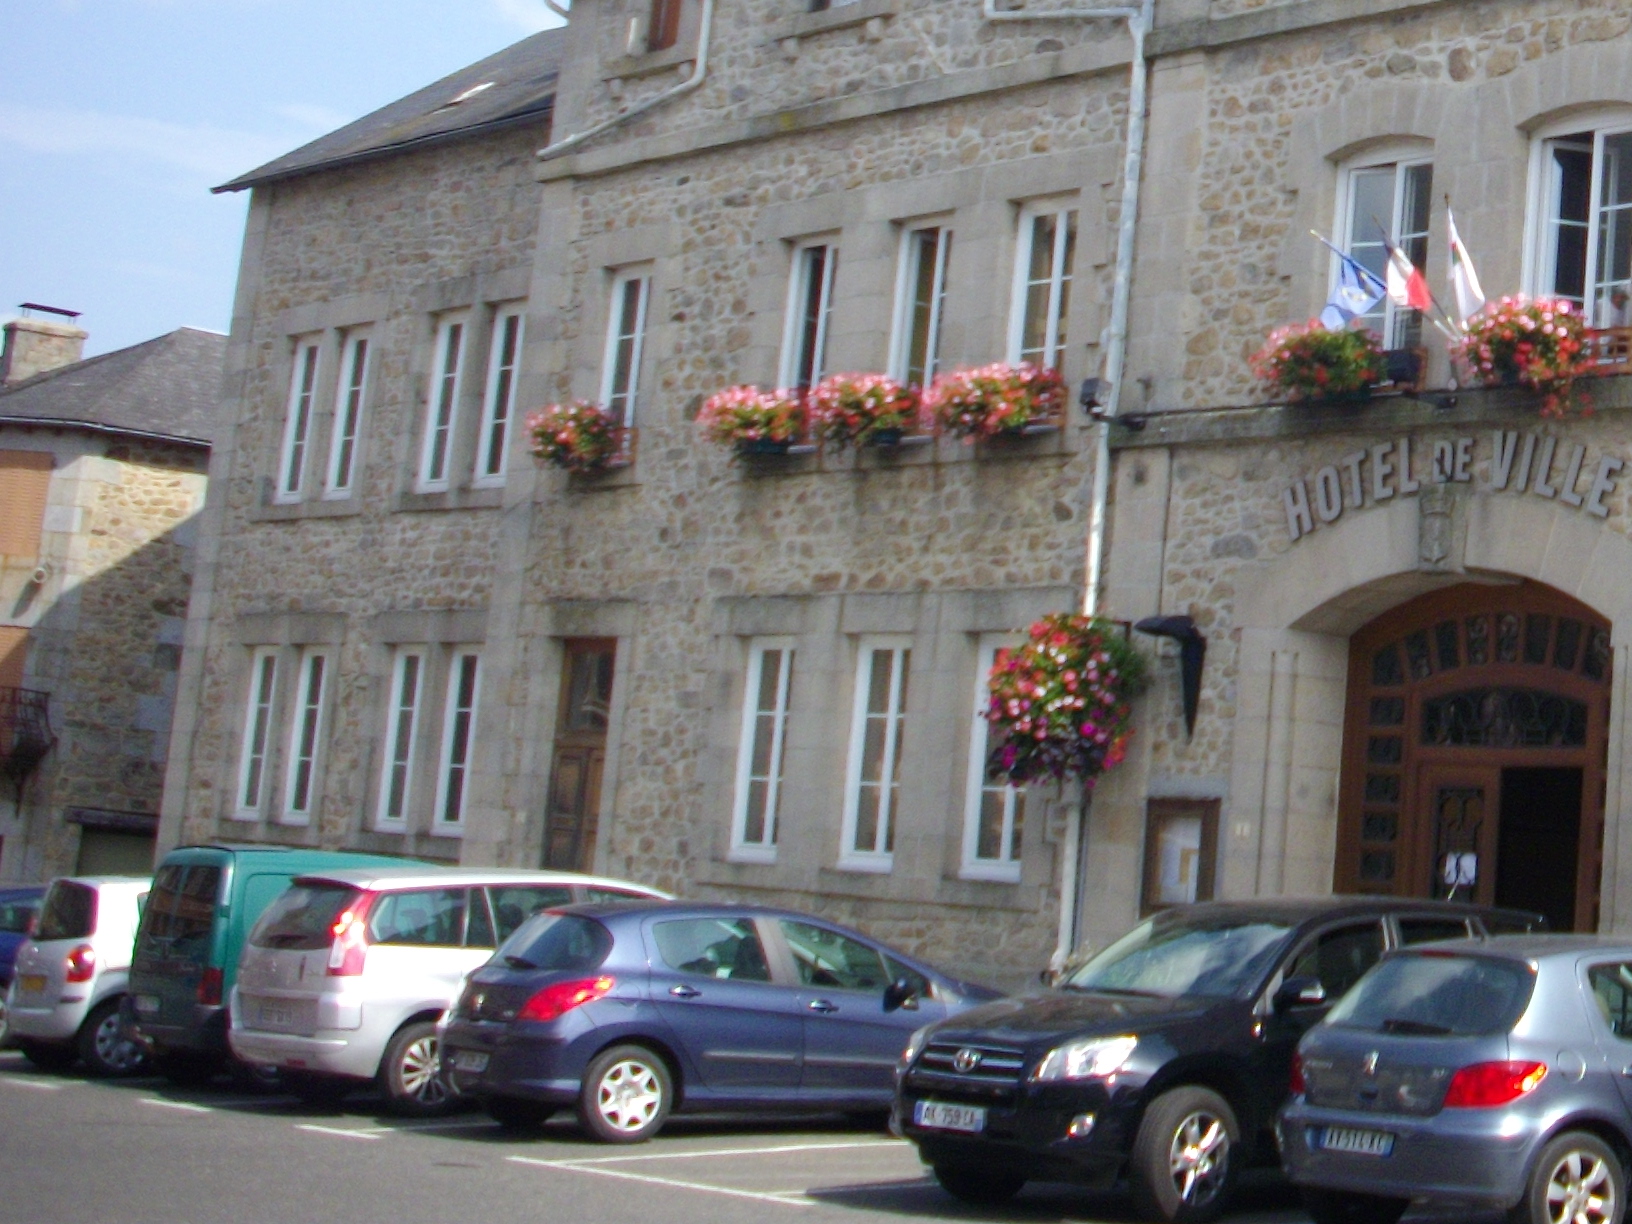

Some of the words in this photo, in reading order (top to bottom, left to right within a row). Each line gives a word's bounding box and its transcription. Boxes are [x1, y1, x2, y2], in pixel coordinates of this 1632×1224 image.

[1282, 436, 1421, 542] HOTEL
[1432, 437, 1475, 483] DE
[1493, 430, 1625, 518] VILLE
